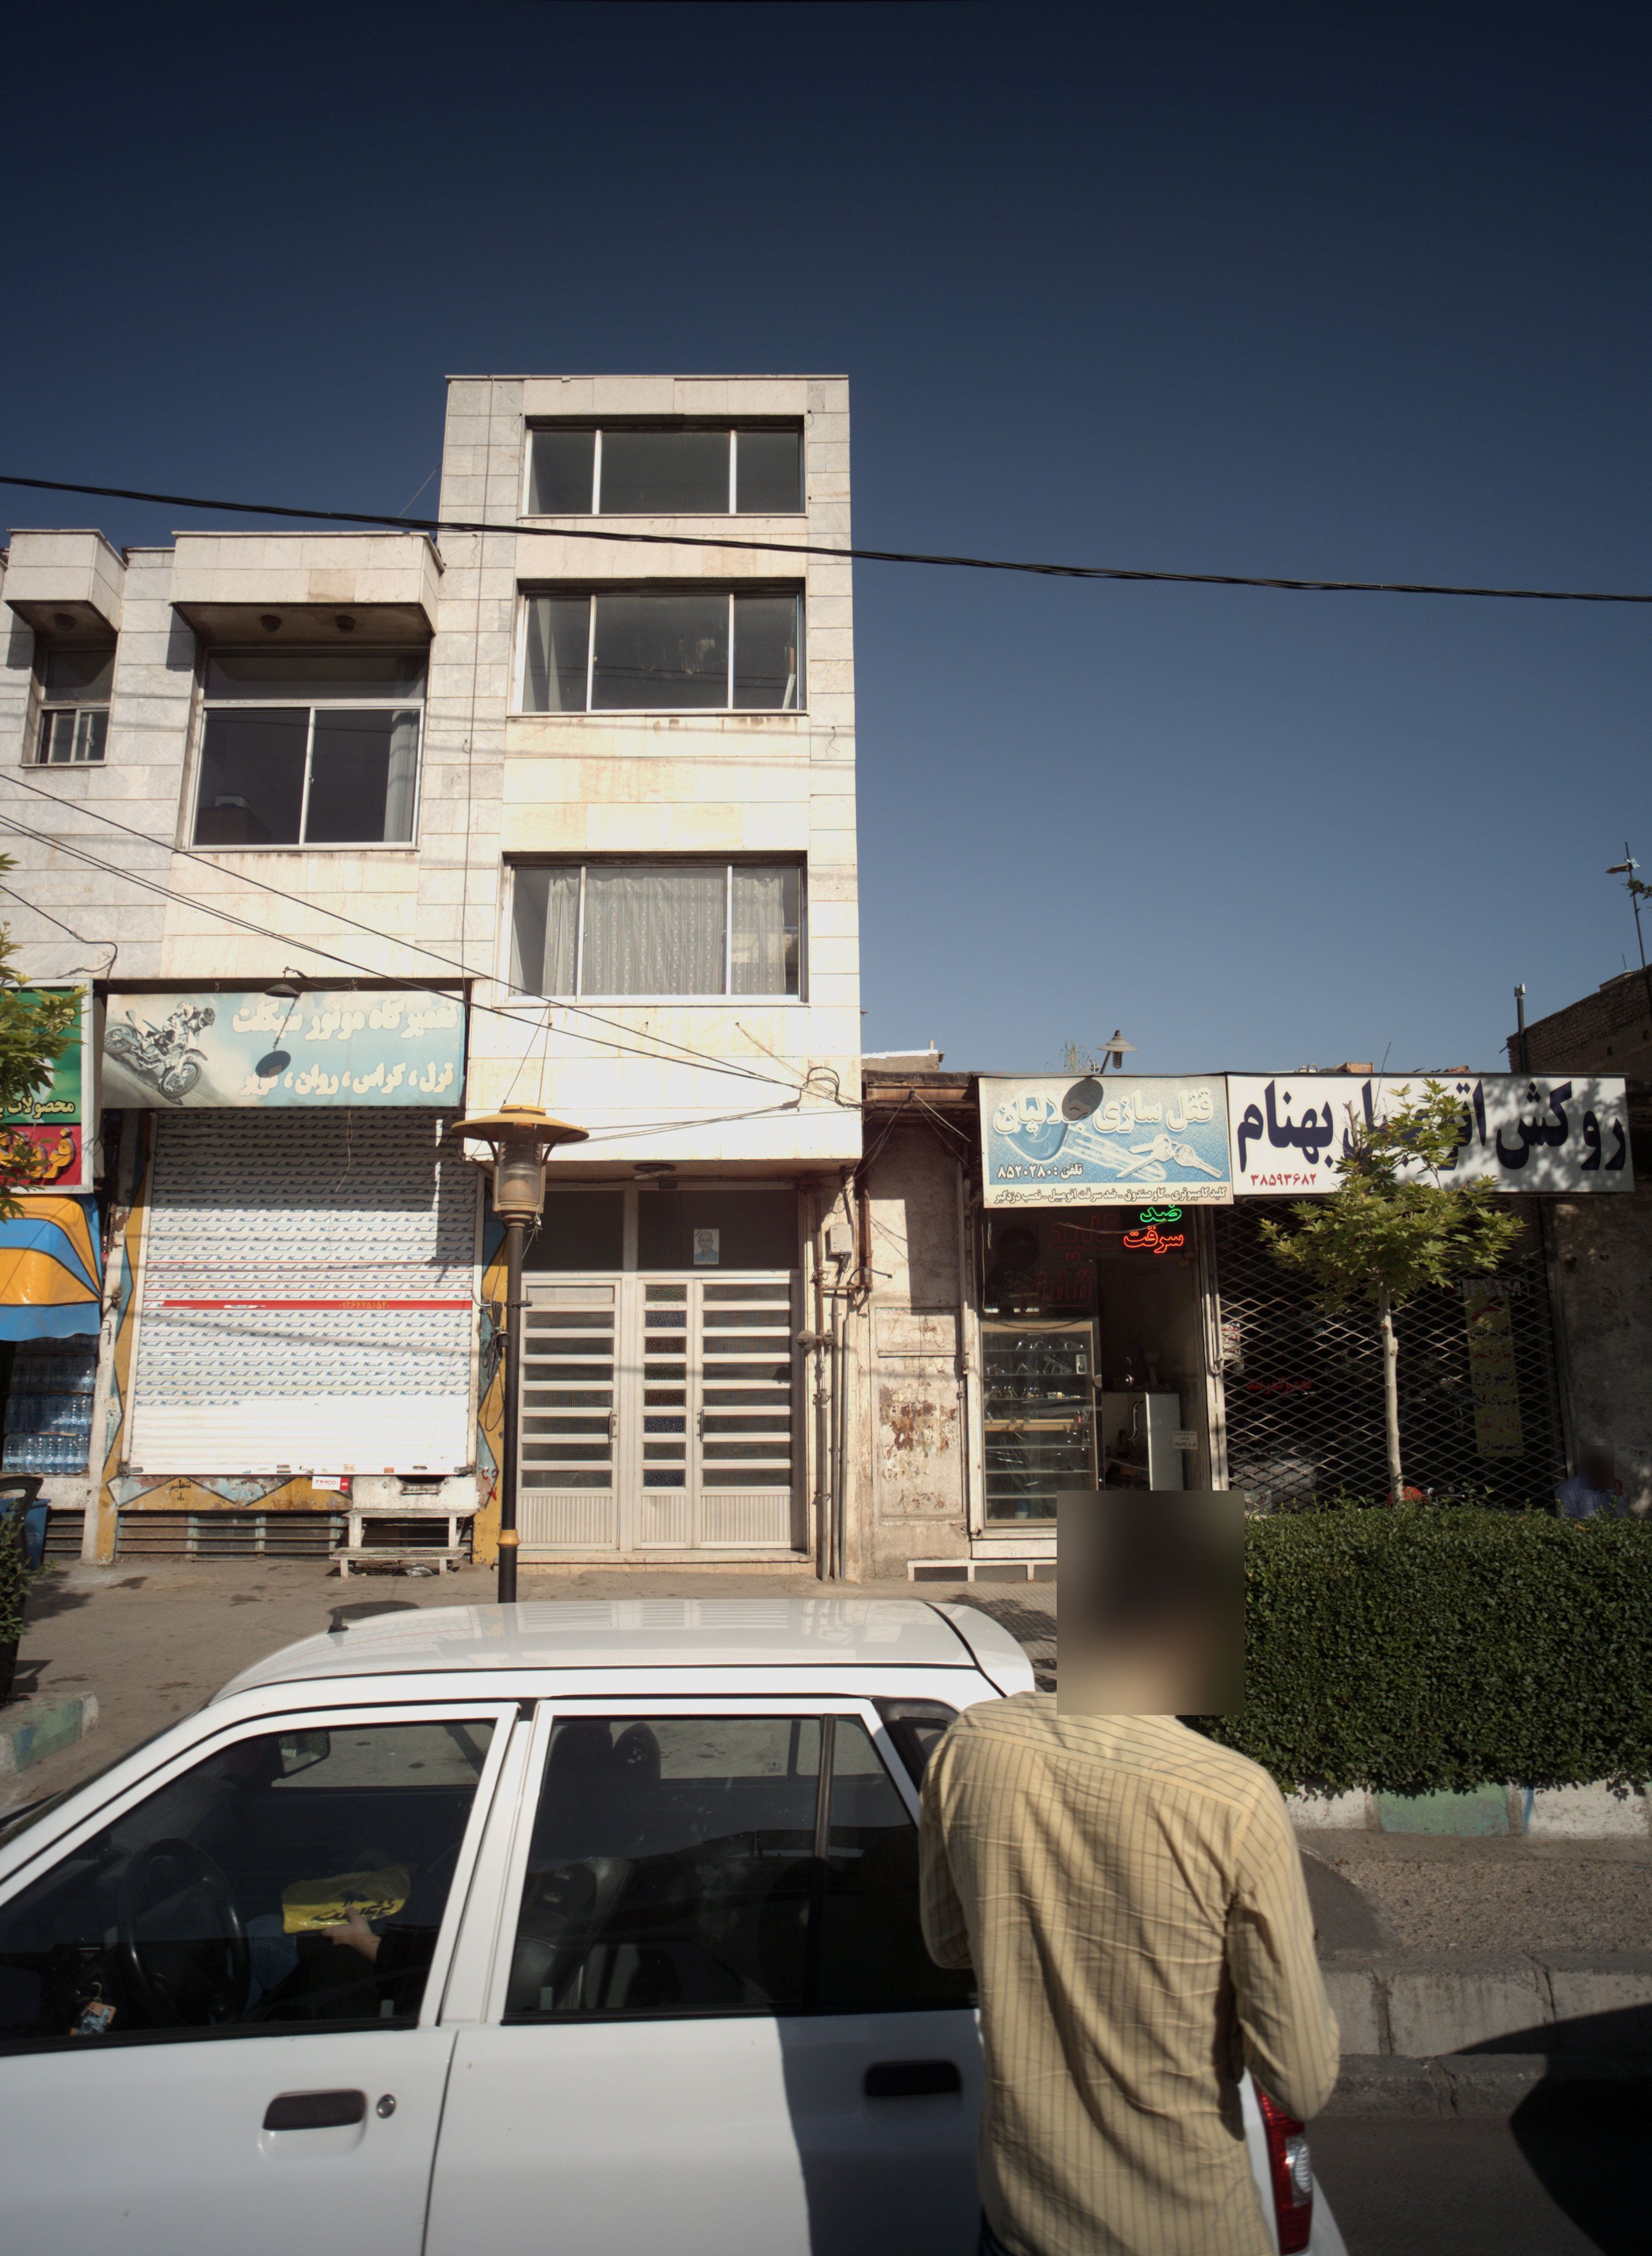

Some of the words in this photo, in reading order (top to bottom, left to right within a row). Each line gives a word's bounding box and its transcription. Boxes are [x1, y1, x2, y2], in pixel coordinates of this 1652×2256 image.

[232, 1000, 303, 1039] سیکلت
[305, 1001, 365, 1040] موتور
[1093, 1089, 1162, 1134] سازی
[1166, 1087, 1215, 1132] قفل
[1237, 1080, 1334, 1173] بهنام
[1103, 1188, 1117, 1200] ضد
[1210, 1186, 1227, 1200] کلید
[1250, 1173, 1317, 1187] ۳۸۵۹۳۶۸۲
[1021, 1189, 1042, 1203] نصب
[1139, 1205, 1182, 1223] ضد
[1123, 1226, 1184, 1254] سرقت
